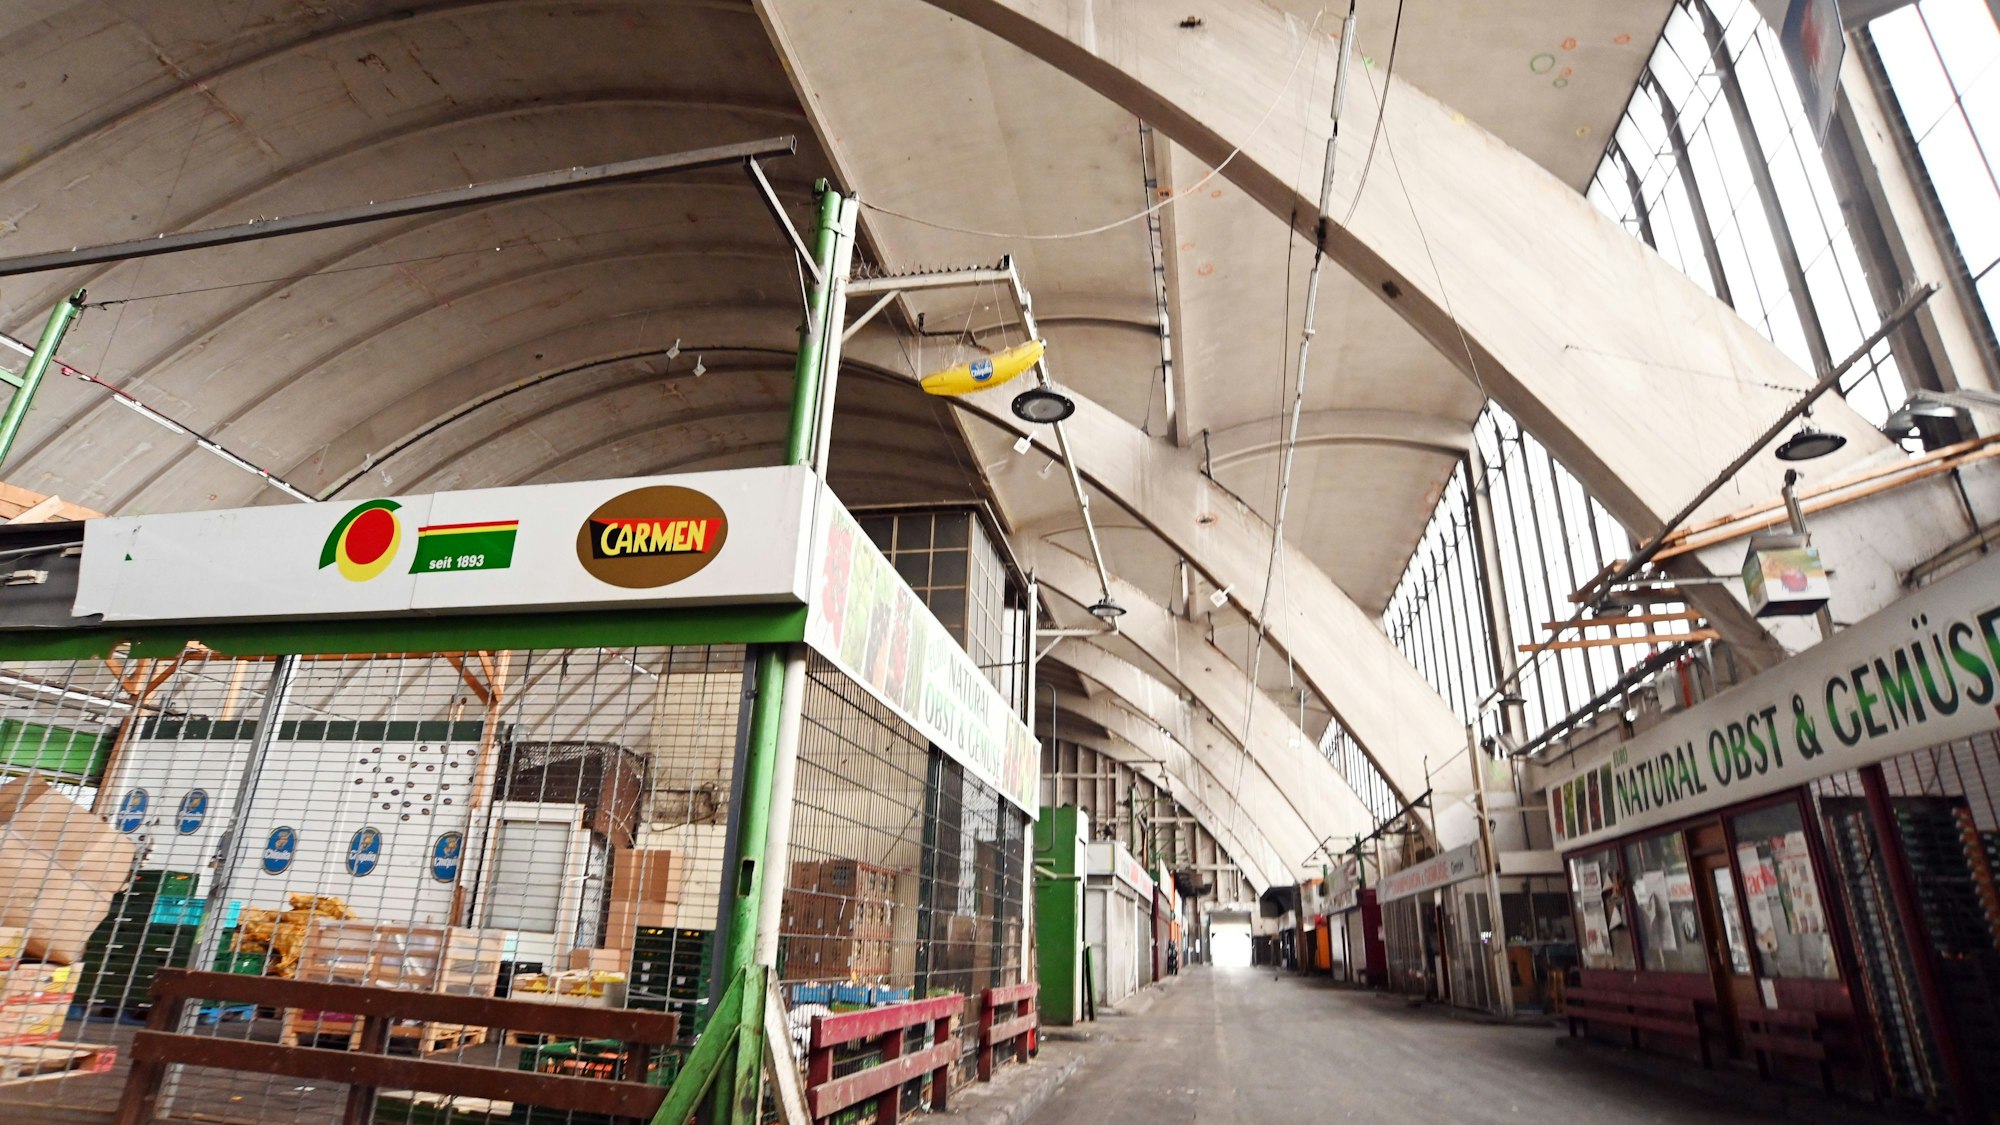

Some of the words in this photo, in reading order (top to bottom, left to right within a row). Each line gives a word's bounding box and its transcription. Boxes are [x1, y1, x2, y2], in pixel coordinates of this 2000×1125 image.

[429, 556, 452, 570] seit
[456, 554, 485, 569] 1893
[600, 519, 707, 557] CARMEN
[924, 682, 956, 742] OBST
[957, 713, 965, 750] &
[948, 653, 990, 727] NATURAL
[1615, 740, 1708, 820] NATURAL
[1708, 704, 1783, 787] OBST
[1792, 693, 1824, 761] &
